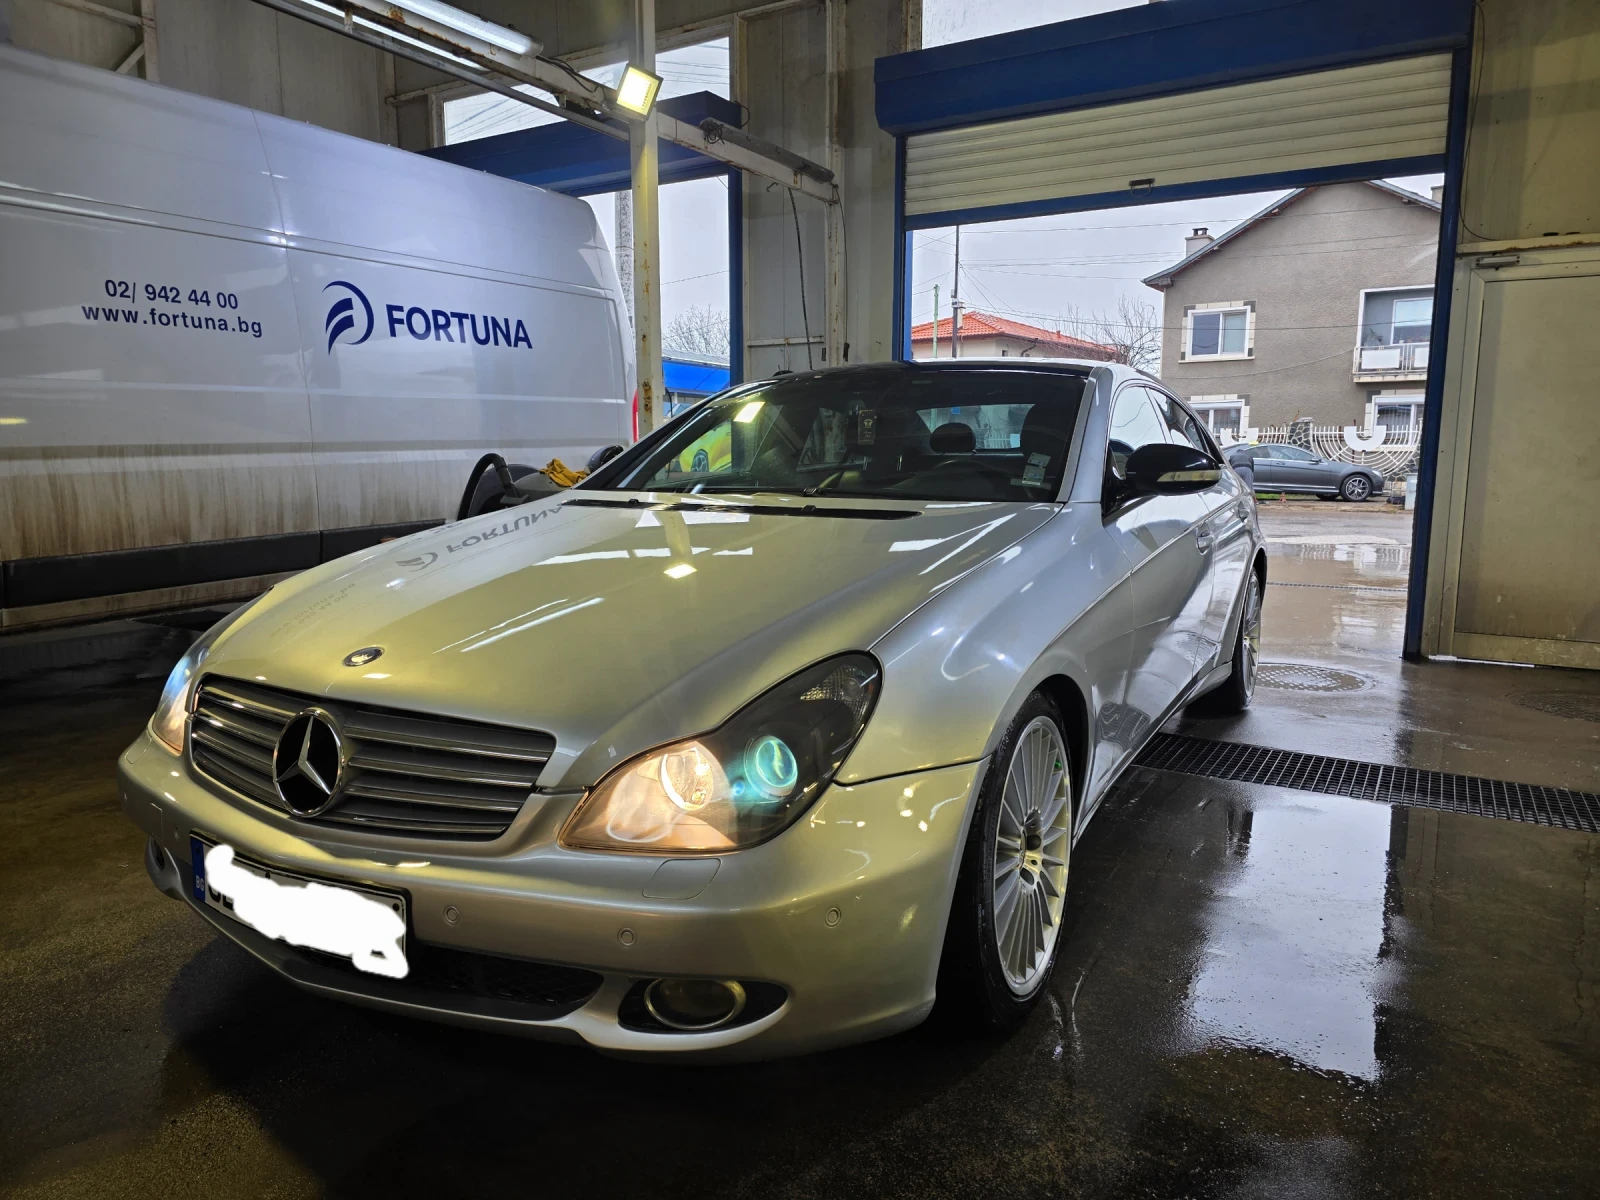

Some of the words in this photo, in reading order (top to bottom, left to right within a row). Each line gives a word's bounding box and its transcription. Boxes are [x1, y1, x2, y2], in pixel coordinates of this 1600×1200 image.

[144, 283, 182, 304] 942
[187, 289, 211, 307] 44
[216, 292, 239, 310] 00
[81, 305, 263, 338] www.fortuna.bg
[385, 303, 534, 349] FORTUNA
[195, 874, 205, 892] BG
